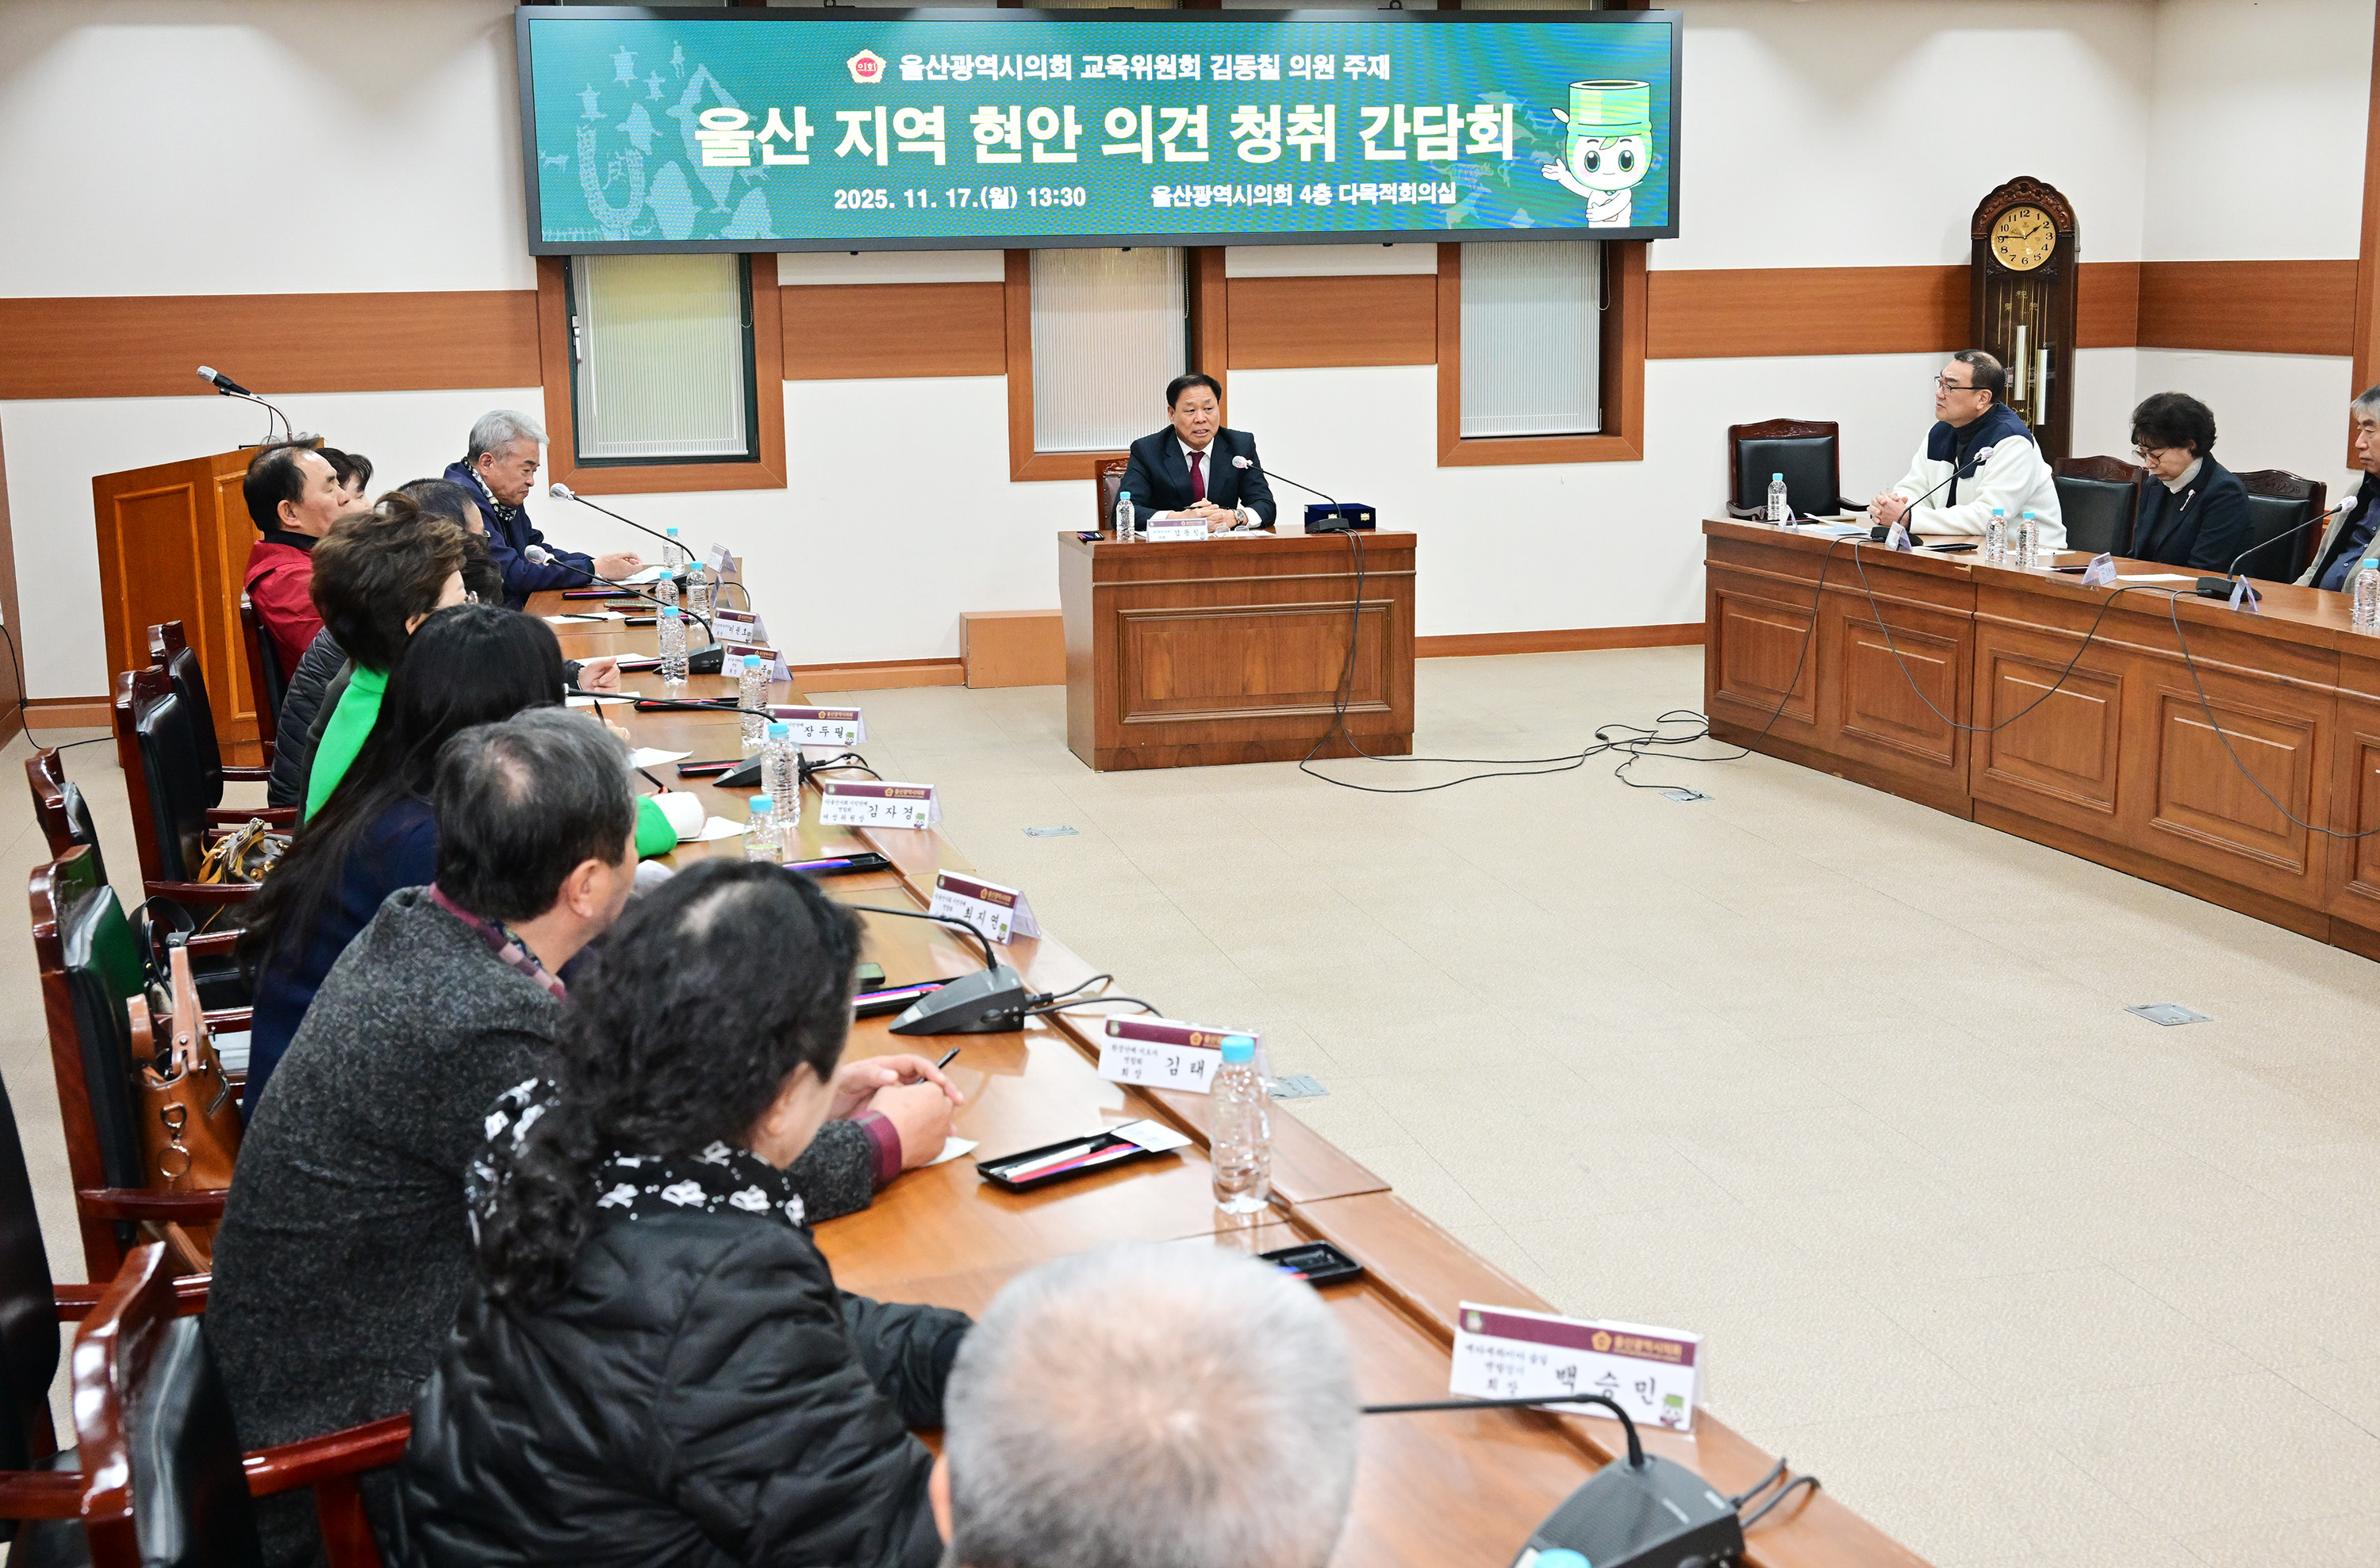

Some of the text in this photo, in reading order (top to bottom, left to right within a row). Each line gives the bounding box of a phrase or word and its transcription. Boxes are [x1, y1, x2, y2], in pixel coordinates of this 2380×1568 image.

[857, 63, 876, 71] 의회
[899, 54, 1390, 80] 울산광역시의회 교육위원회 김동칠 의원 주재
[694, 103, 1514, 167] 울산 지역 현안 의견 청취 간담회
[834, 186, 1086, 209] 2025. 11. 17.(월) 13:30
[1150, 182, 1457, 207] 울산광역시의회 4층 다목적회의실
